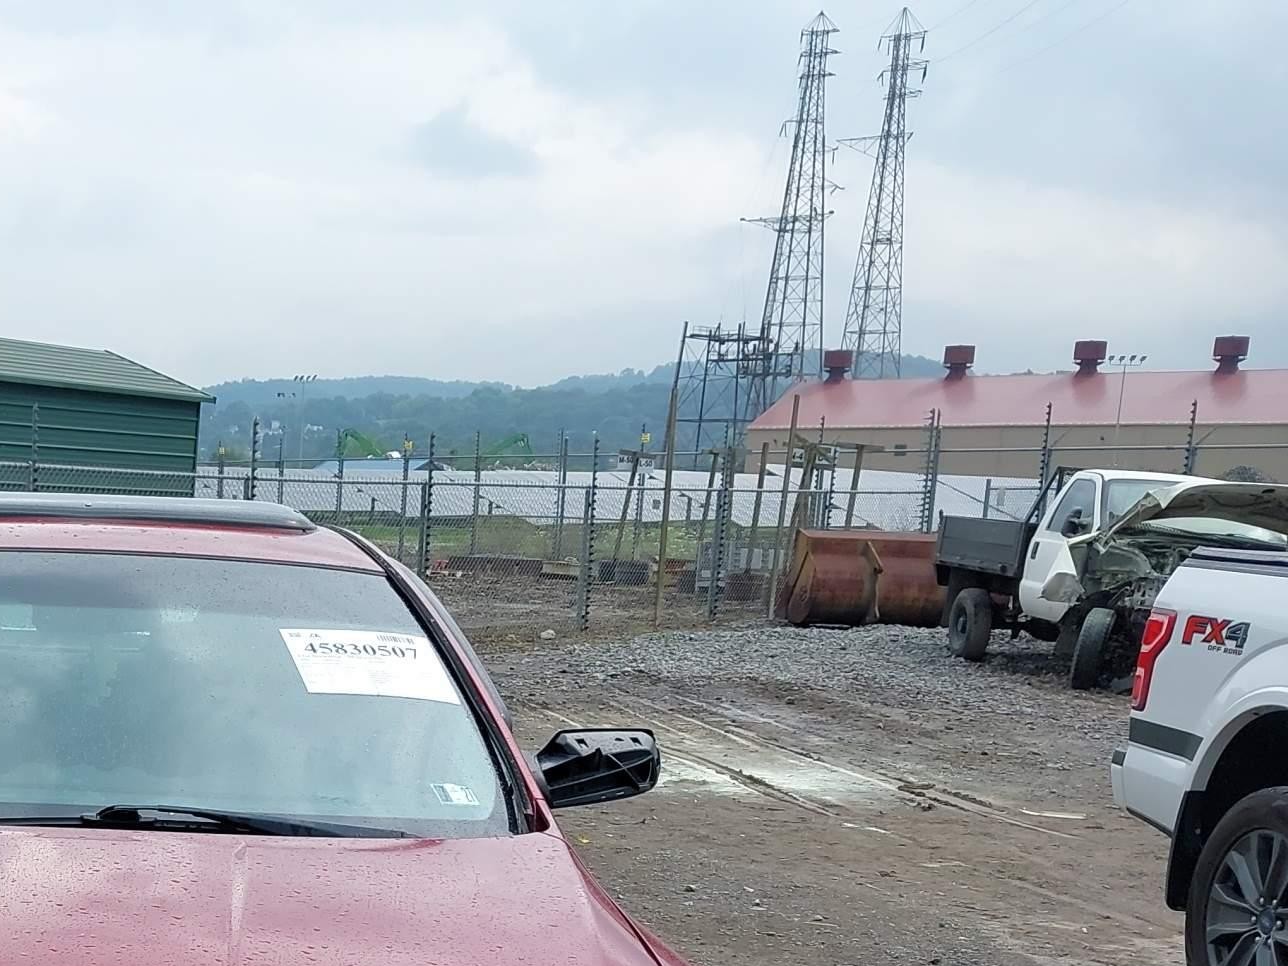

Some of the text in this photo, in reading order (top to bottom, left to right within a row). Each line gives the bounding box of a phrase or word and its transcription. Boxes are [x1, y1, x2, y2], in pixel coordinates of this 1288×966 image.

[1182, 615, 1251, 648] FX4
[304, 641, 417, 660] 45830507
[1207, 644, 1222, 652] OFF
